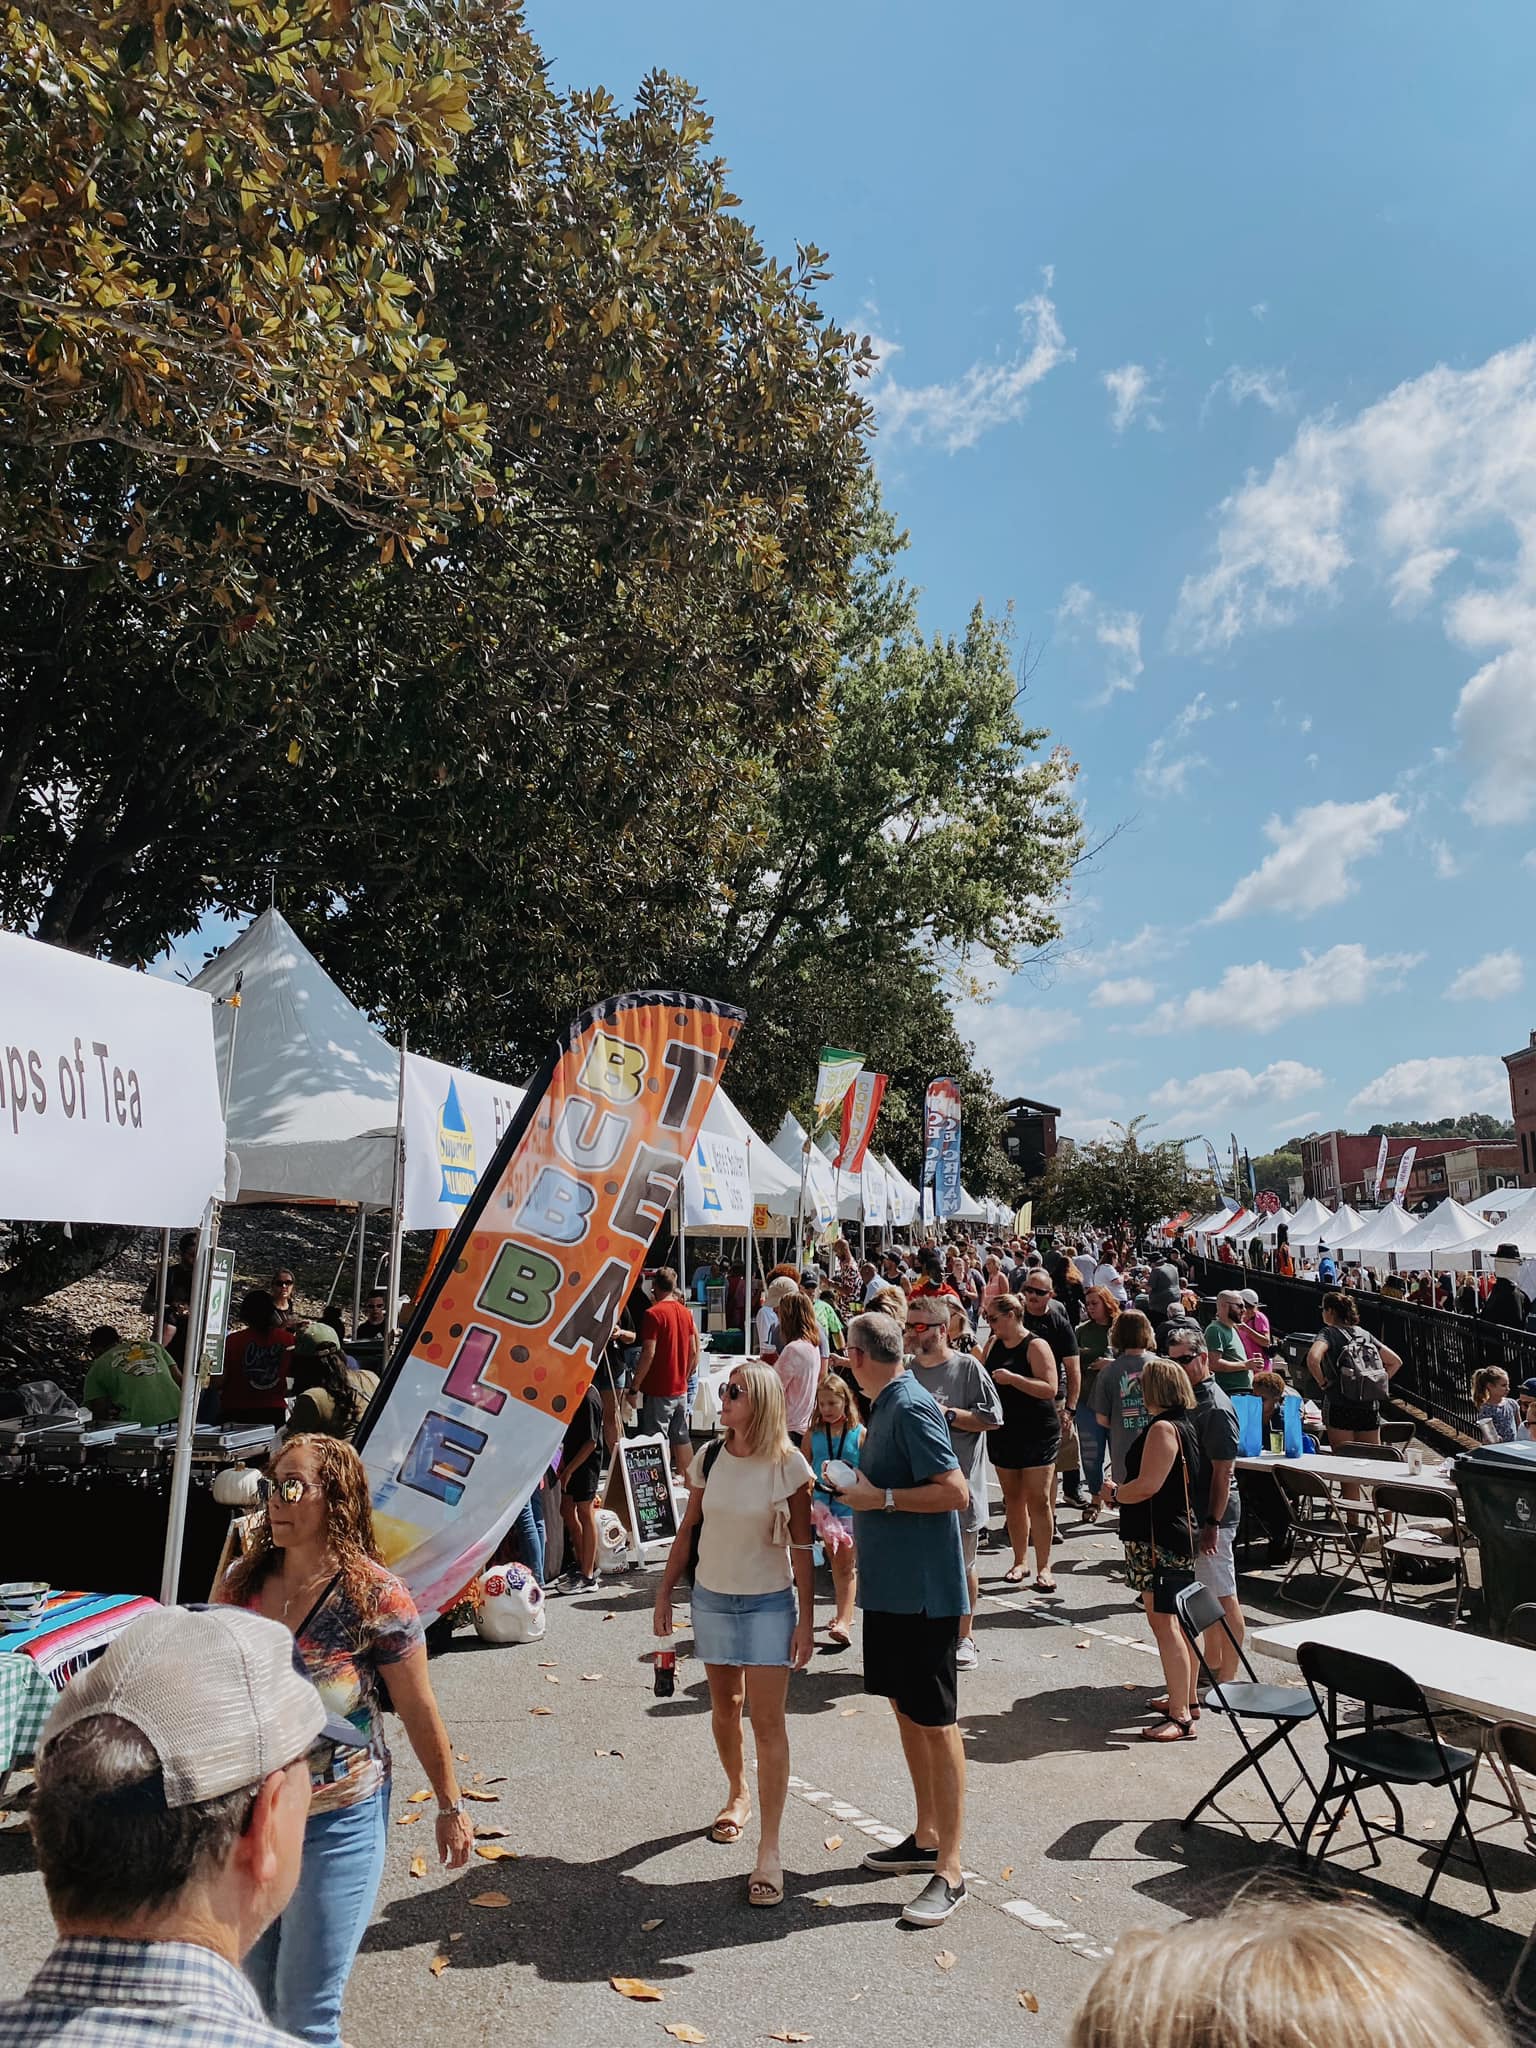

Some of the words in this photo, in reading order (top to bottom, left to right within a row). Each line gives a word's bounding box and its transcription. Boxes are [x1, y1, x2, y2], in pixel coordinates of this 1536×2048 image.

[0, 1046, 47, 1134] ps
[58, 1037, 86, 1119] of
[92, 1041, 142, 1128] Tea
[550, 1040, 718, 1366] TEA
[395, 1029, 649, 1509] BUBBLE
[1123, 1417, 1135, 1428] BE
[632, 1470, 650, 1483] TACOS
